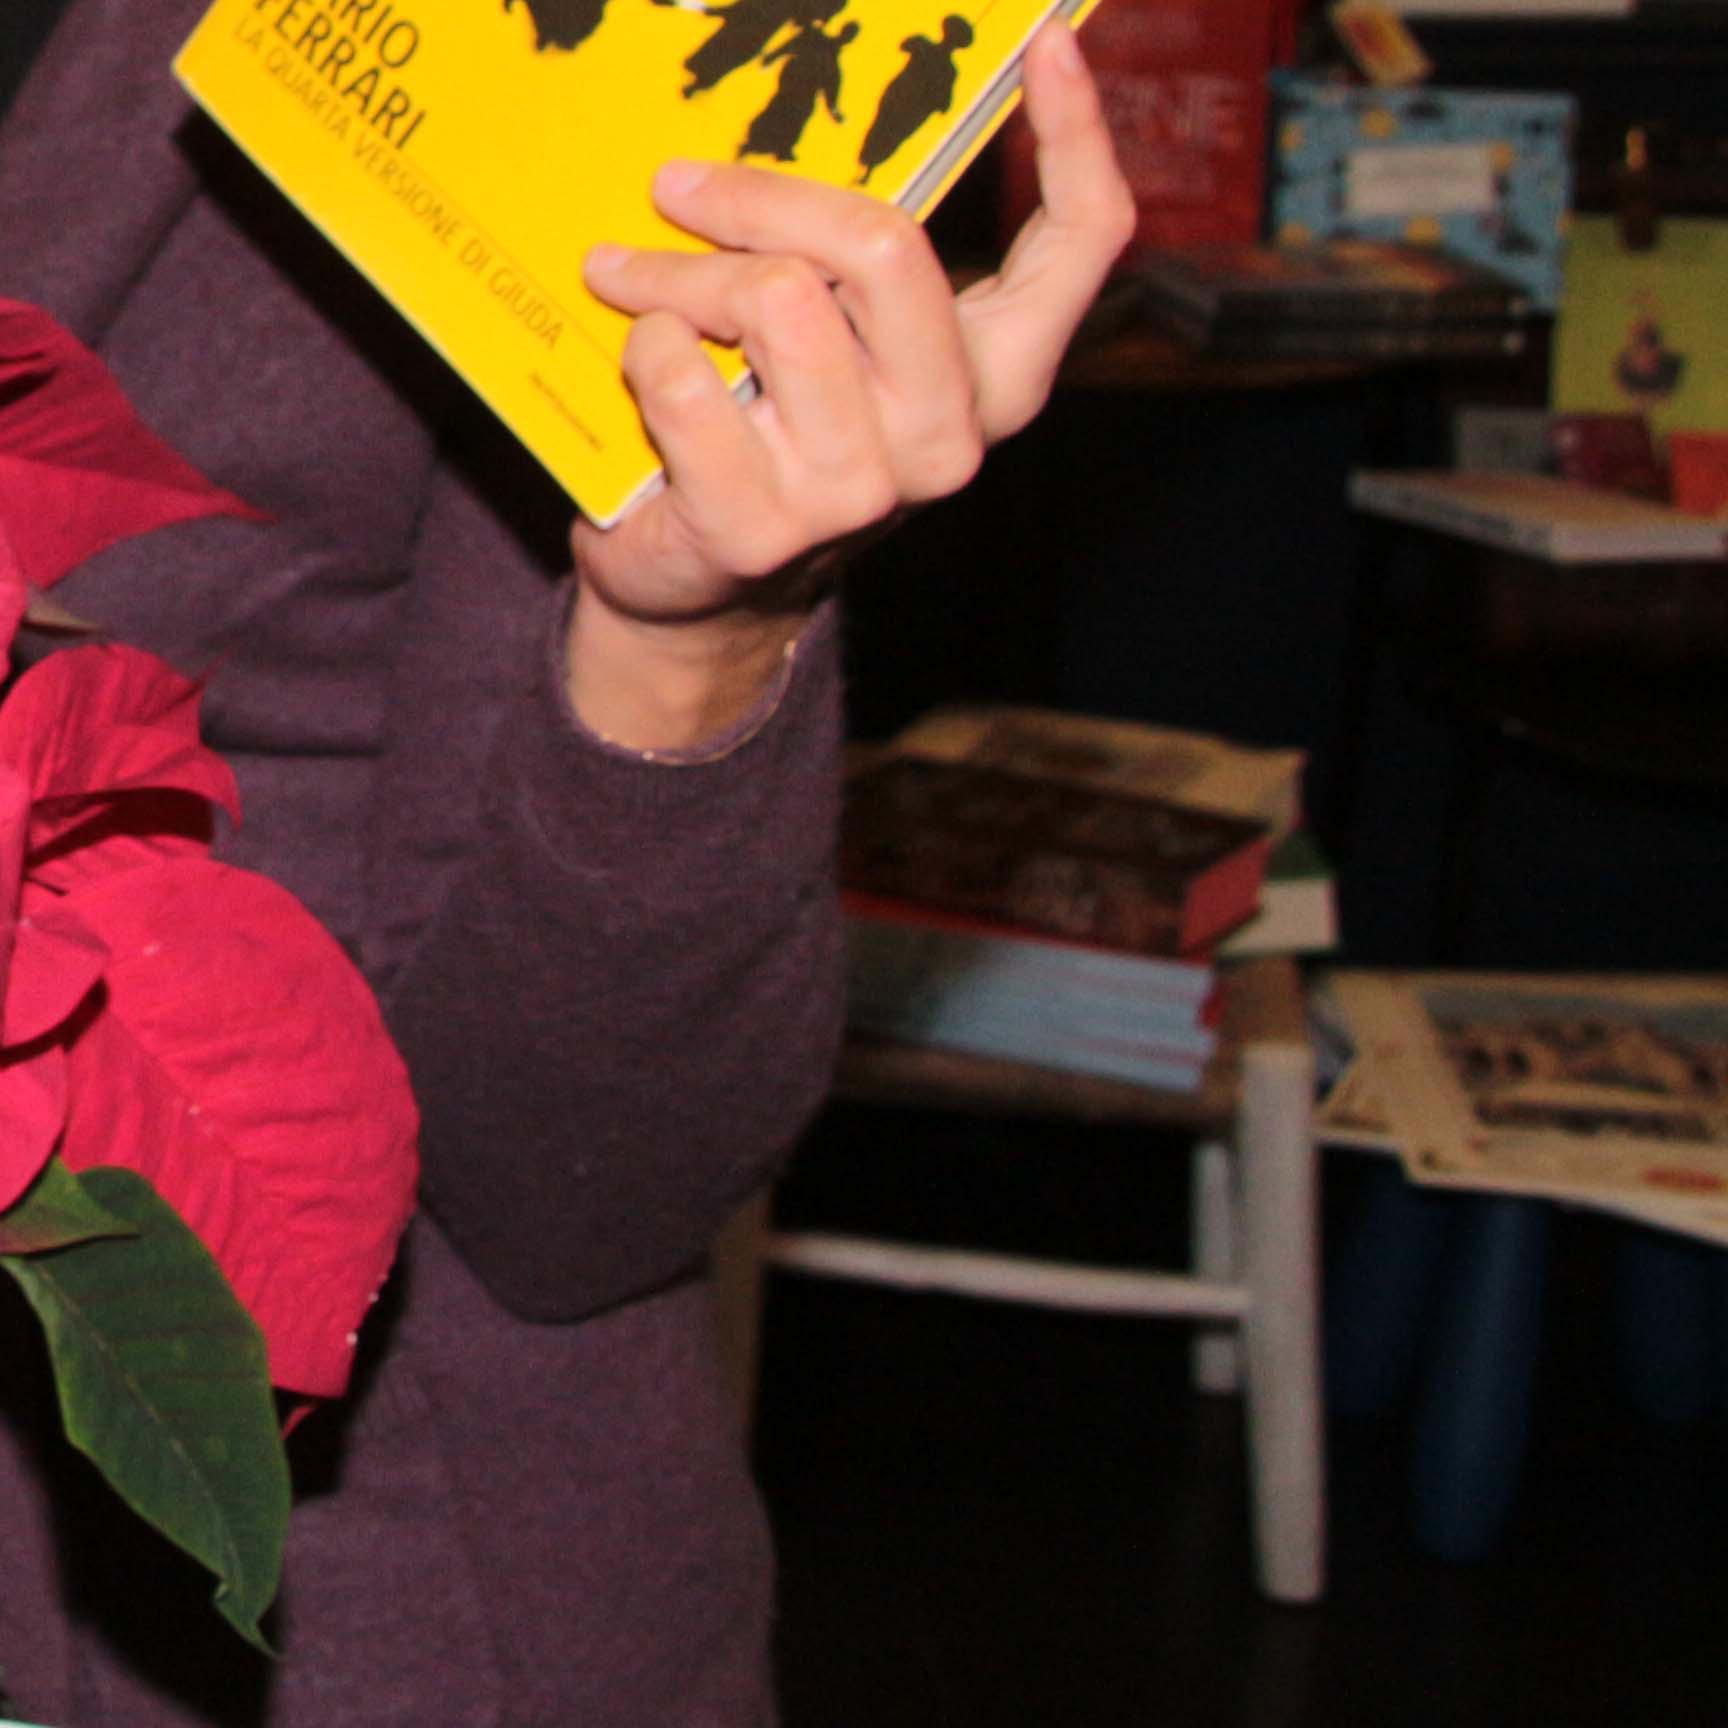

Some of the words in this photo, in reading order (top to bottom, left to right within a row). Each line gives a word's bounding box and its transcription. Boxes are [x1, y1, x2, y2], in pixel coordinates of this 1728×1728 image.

[233, 14, 266, 59] LA
[262, 44, 352, 145] QUARTA
[351, 122, 458, 250] VERSIONE
[456, 235, 492, 275] DI
[487, 257, 566, 351] GIUDA
